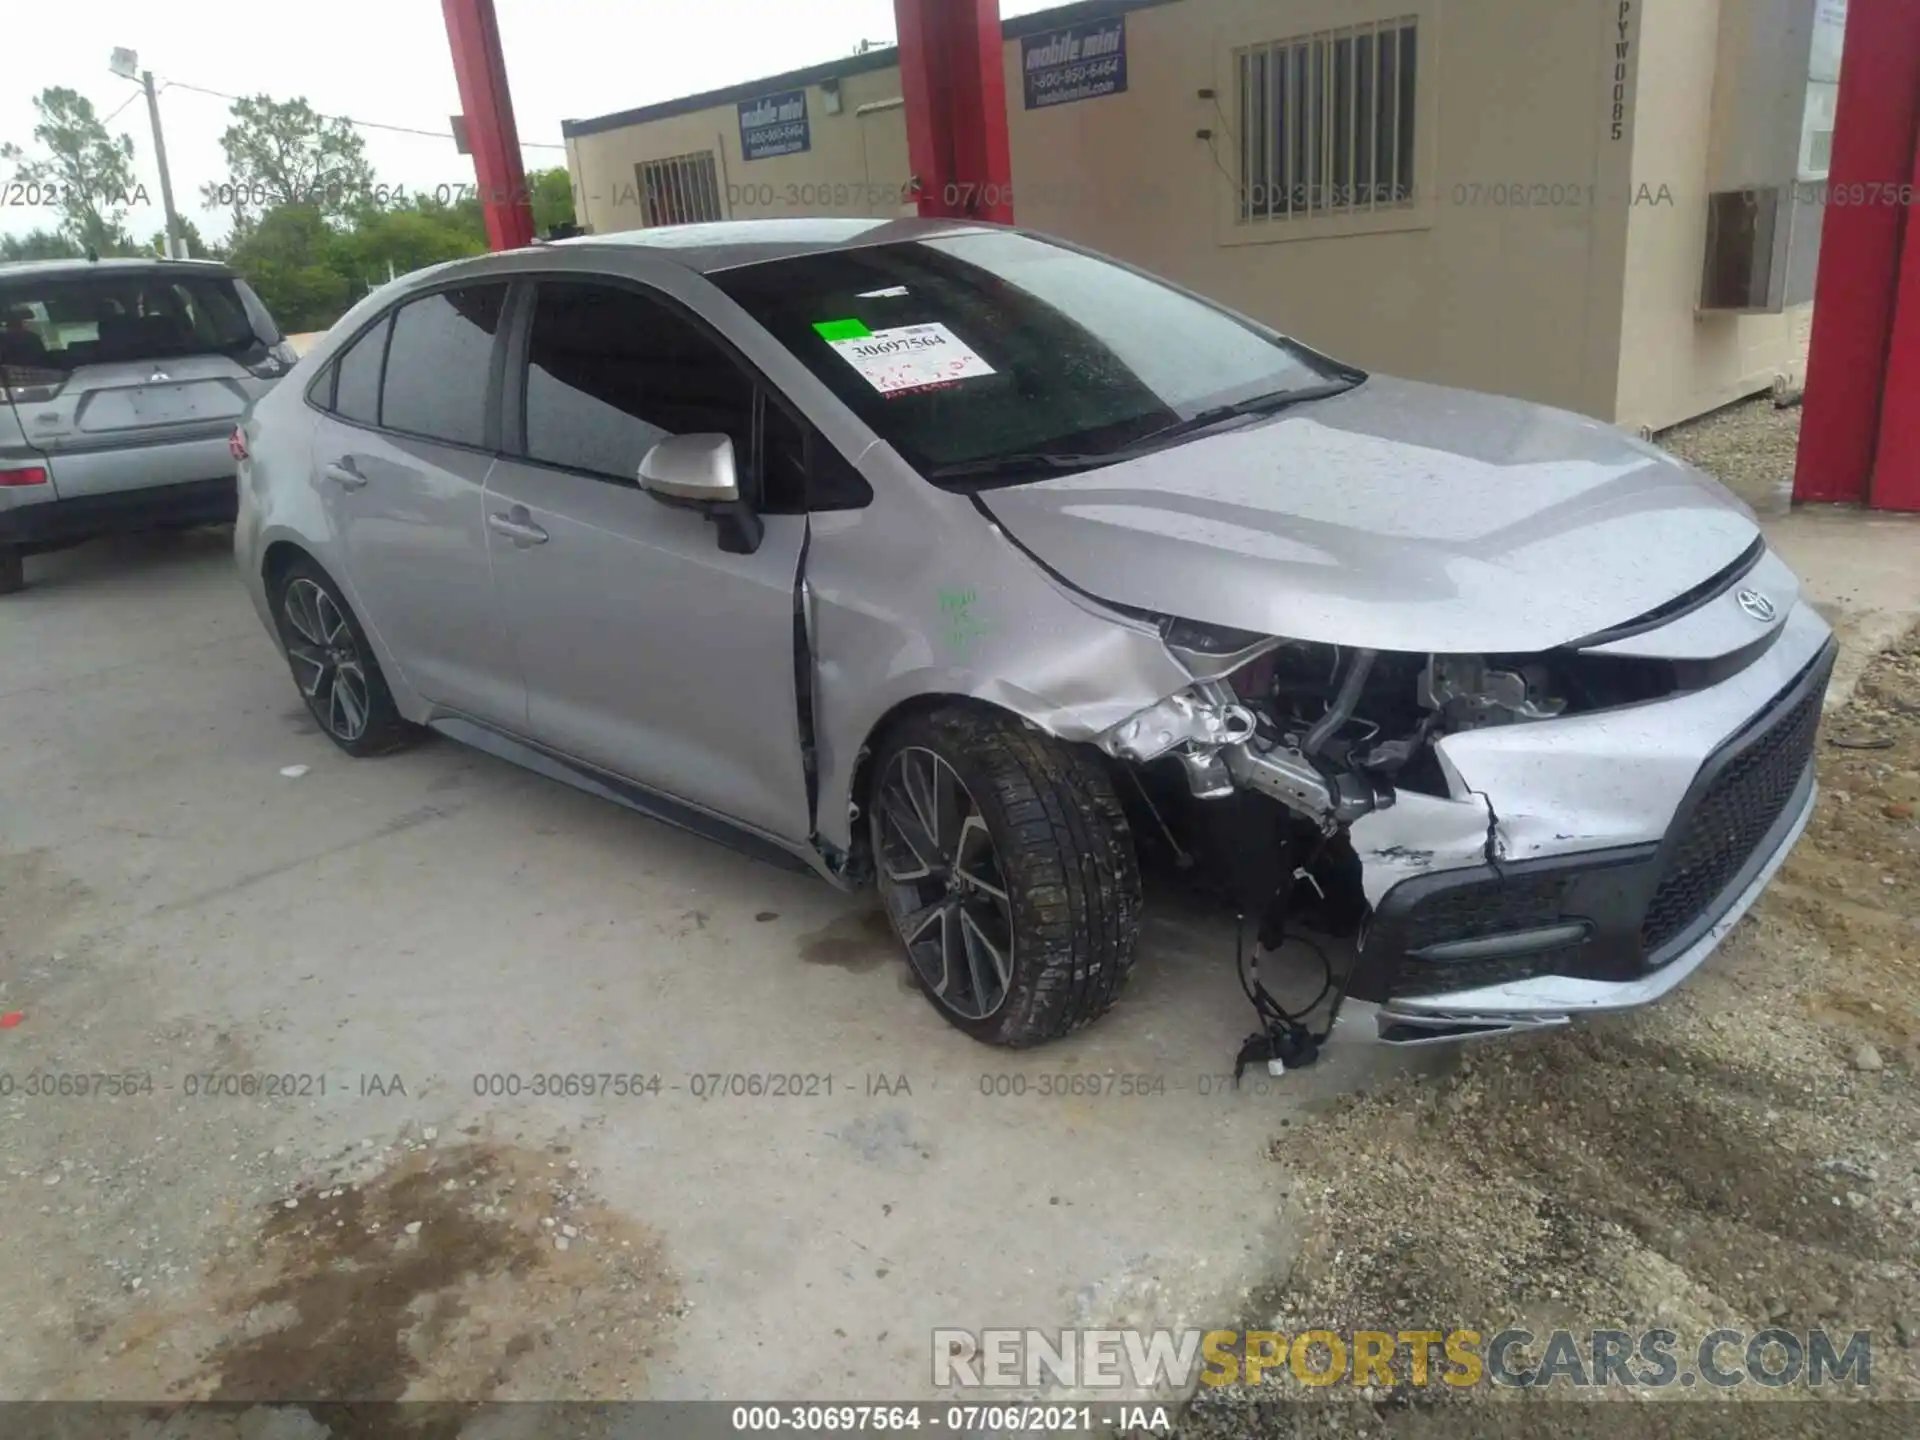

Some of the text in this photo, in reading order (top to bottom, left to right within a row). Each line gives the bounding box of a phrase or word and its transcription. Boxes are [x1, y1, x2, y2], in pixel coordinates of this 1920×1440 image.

[1026, 24, 1121, 70] mobile mini
[852, 335, 946, 357] 30697564
